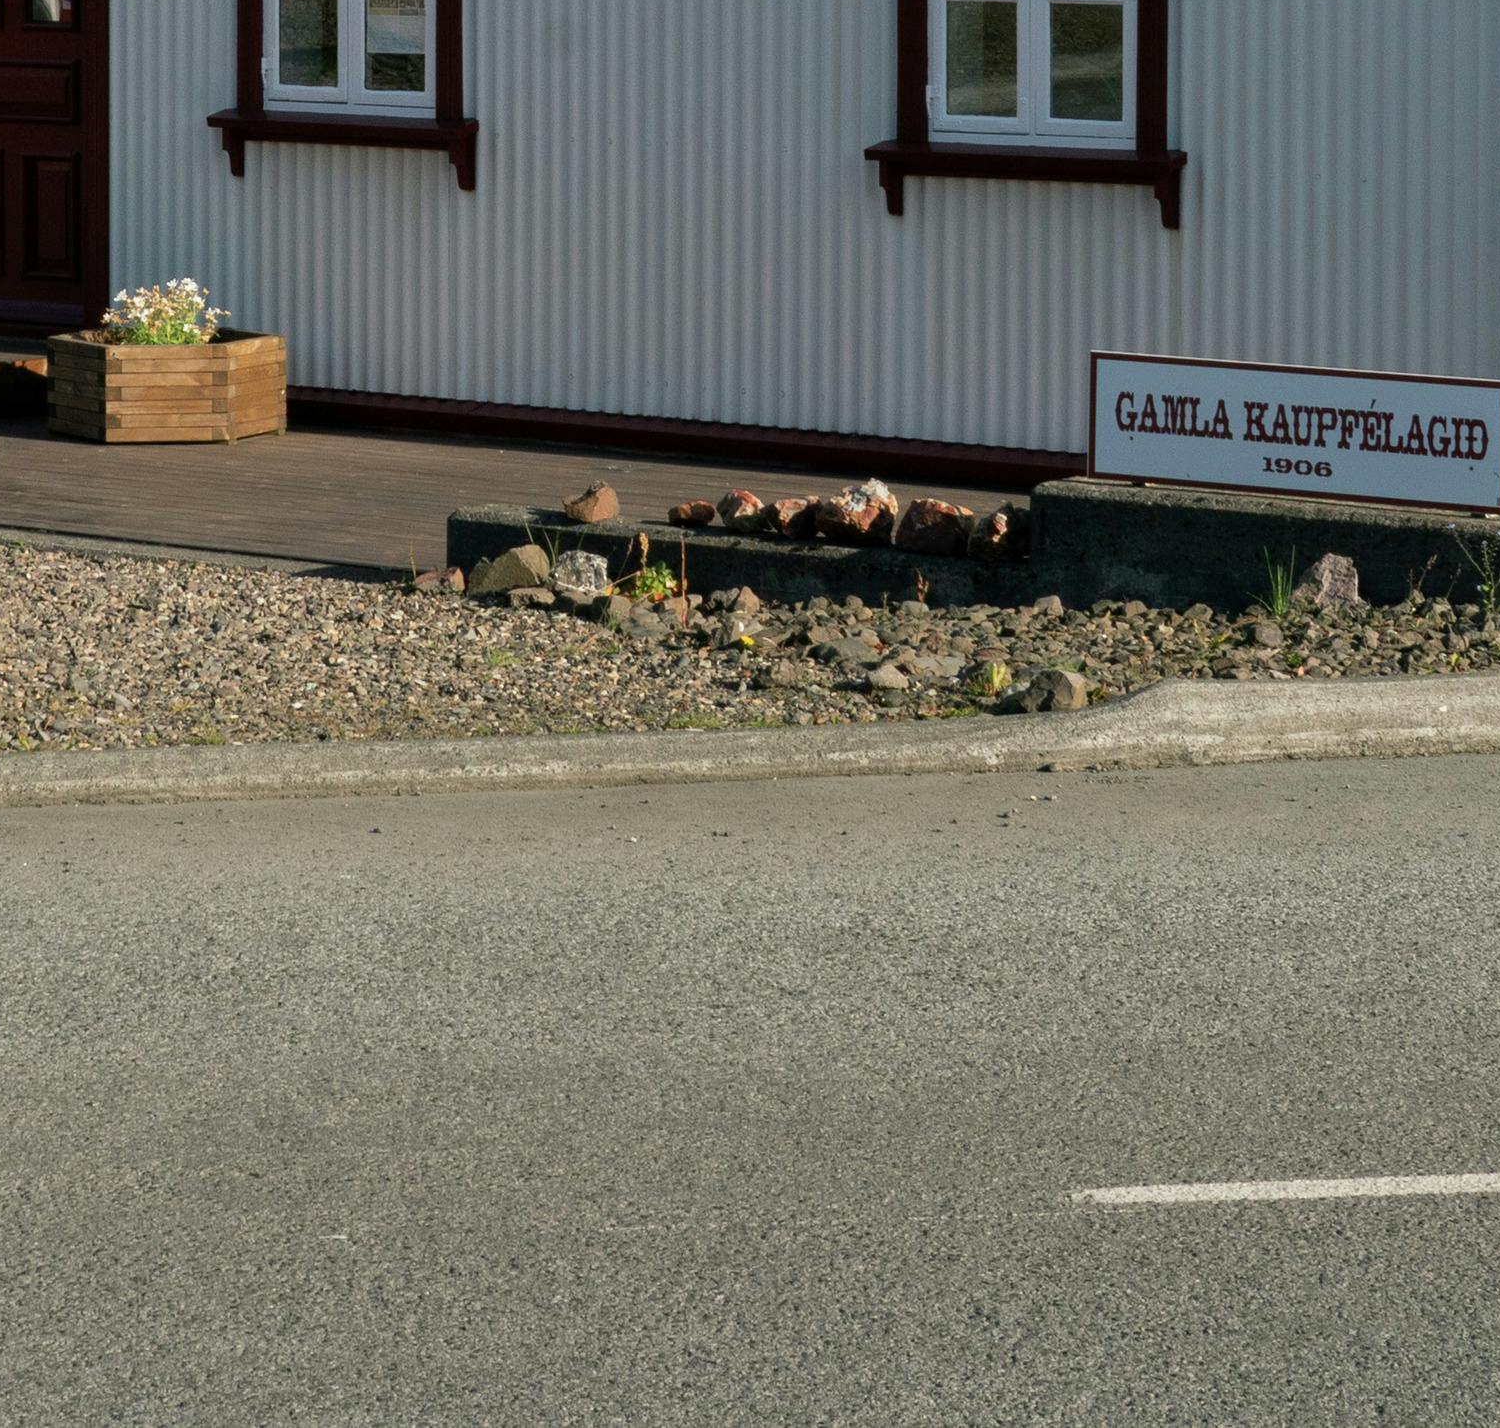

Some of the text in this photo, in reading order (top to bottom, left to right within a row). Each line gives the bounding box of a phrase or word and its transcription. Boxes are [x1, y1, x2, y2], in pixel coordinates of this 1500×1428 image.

[1115, 391, 1490, 461] GAMLA KAUPFÉLAGIÐ
[1262, 456, 1333, 478] 1906
